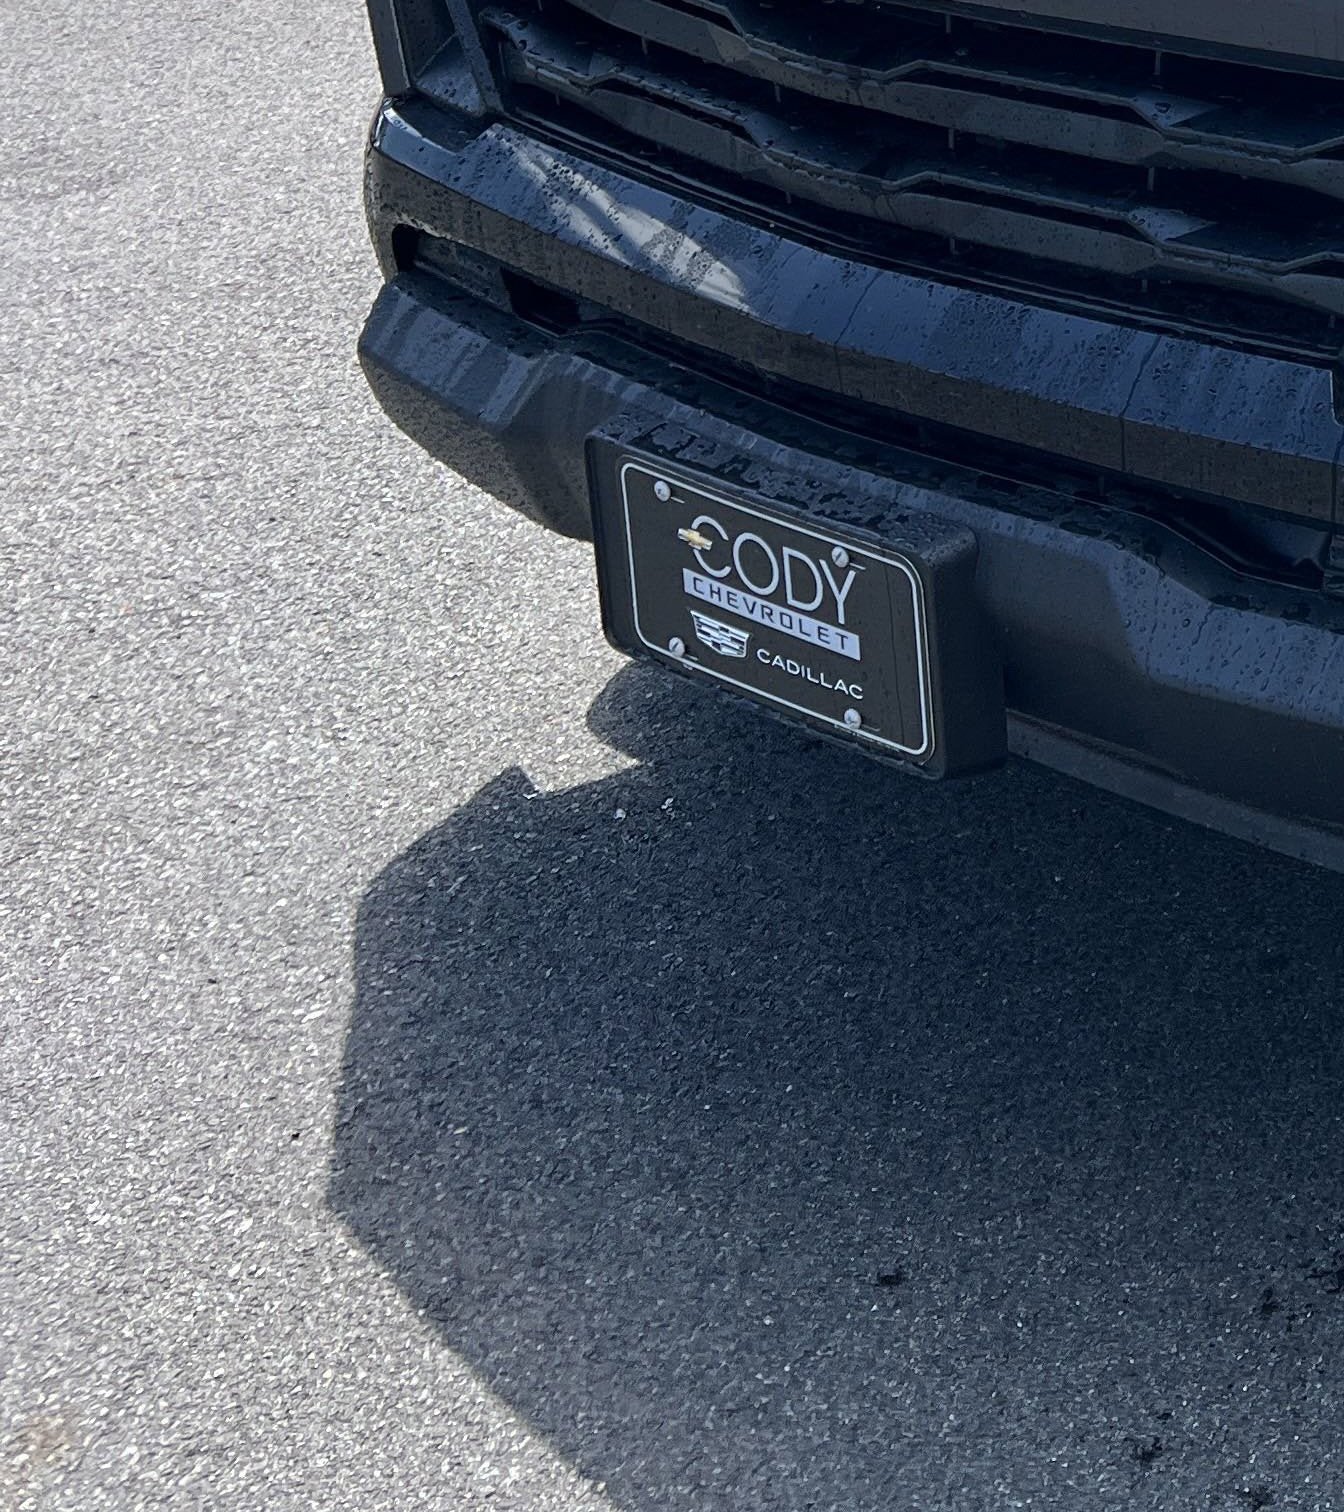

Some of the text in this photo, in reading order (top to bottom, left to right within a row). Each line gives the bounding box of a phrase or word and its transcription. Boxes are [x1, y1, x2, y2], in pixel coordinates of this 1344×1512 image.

[690, 515, 856, 624] CODY
[692, 576, 849, 651] CHEVROLET
[756, 648, 864, 700] CADILLAC
